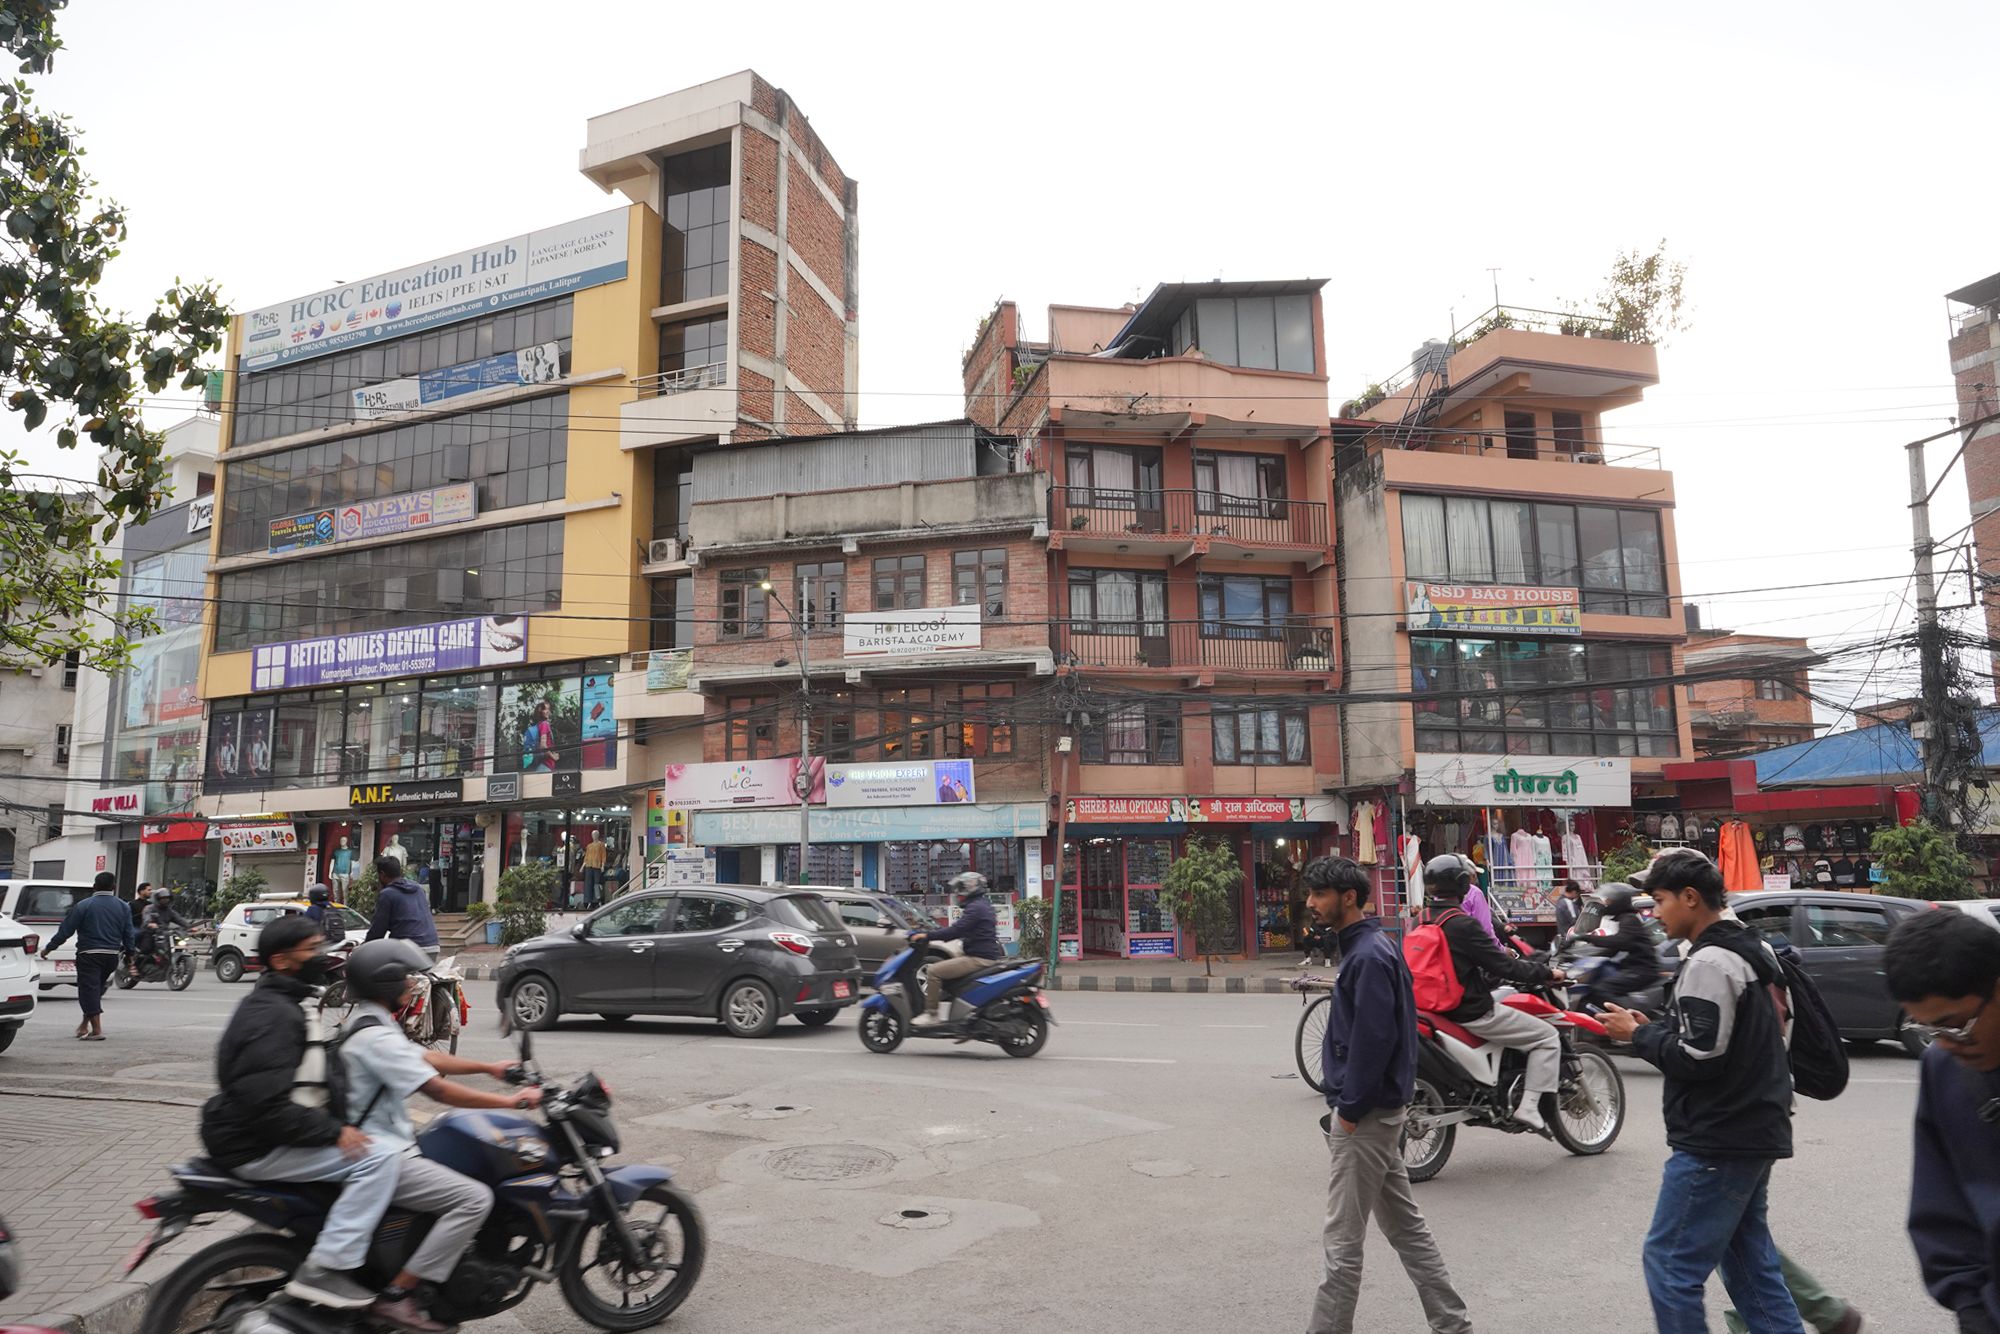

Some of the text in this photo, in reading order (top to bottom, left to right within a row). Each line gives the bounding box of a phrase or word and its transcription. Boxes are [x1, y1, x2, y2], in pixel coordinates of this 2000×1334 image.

[530, 239, 609, 266] JAPANESE KOREAN
[531, 229, 615, 257] LANGUAGE CLASSES
[290, 244, 517, 323] HCRC Education Hub
[408, 272, 509, 310] IELTS PTE SAT
[501, 275, 582, 302] Kumaripati, Lalitpur
[405, 398, 419, 410] HUB
[364, 491, 433, 519] NEWS
[363, 513, 408, 527] EDUCATION
[363, 523, 408, 536] FOUNDATION
[1430, 586, 1574, 601] SSD BAG HOUSE
[290, 621, 475, 669] BETTER SMILES DENTAL CARE
[858, 632, 966, 647] BARISTA ACADEMY
[320, 667, 354, 680] Kumaripati,
[379, 662, 401, 673] Phone:
[401, 657, 436, 671] 01-5539724
[895, 767, 928, 778] EXPERT
[1493, 767, 1579, 796] चौबन्दी
[92, 794, 138, 812] PINK VILLA
[350, 785, 394, 805] A.N.F.
[395, 789, 458, 802] Authentic New Fashion
[1080, 800, 1169, 814] SHREE RAM OPTICALS
[1225, 801, 1243, 814] राम
[721, 814, 760, 830] BEST
[818, 811, 889, 828] OPTICAL
